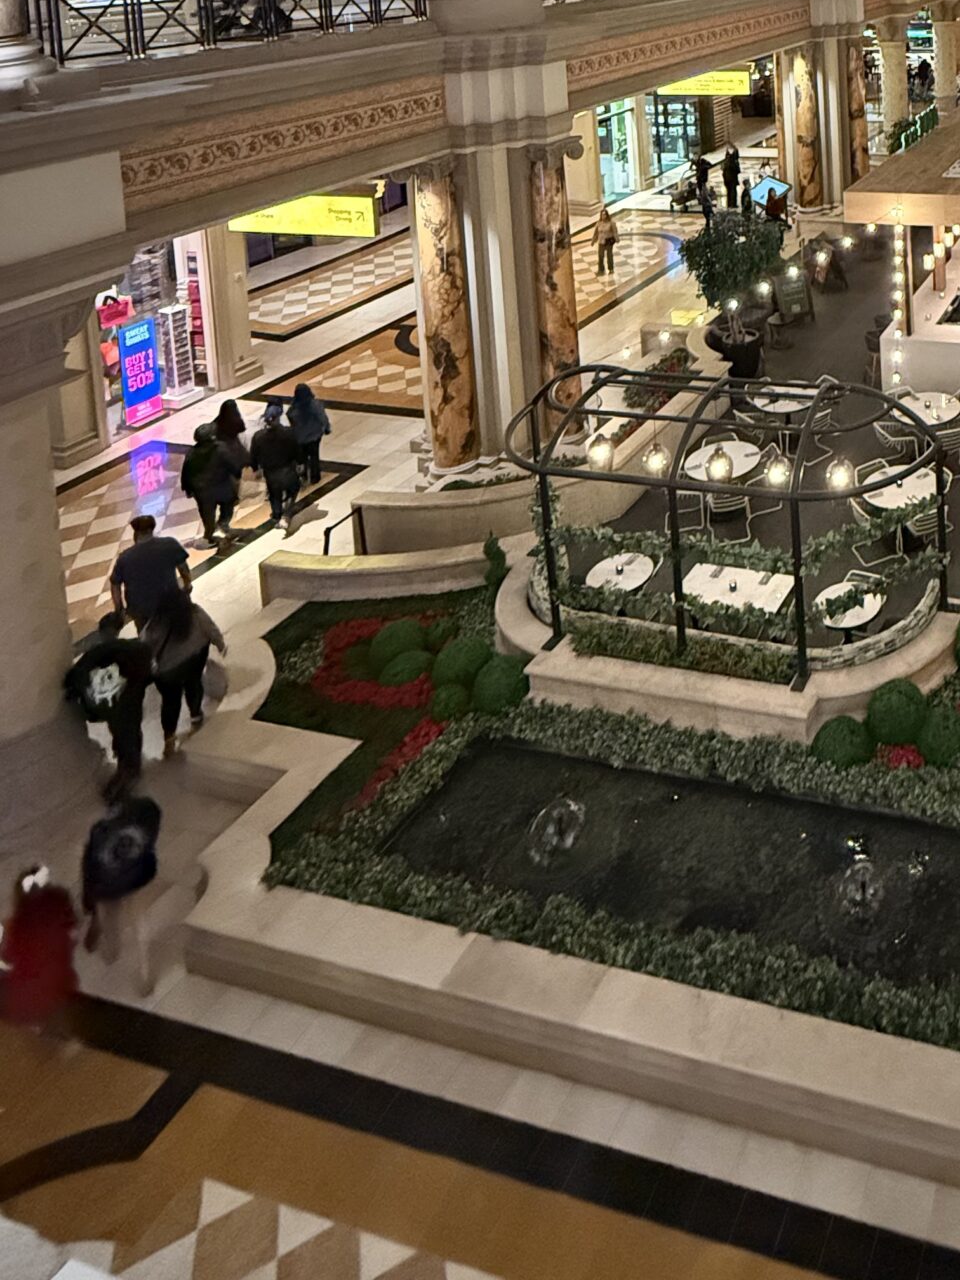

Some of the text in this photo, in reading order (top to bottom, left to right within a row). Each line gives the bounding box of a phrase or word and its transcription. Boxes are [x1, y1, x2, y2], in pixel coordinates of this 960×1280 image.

[125, 348, 154, 369] BUY 1
[126, 361, 146, 377] GET
